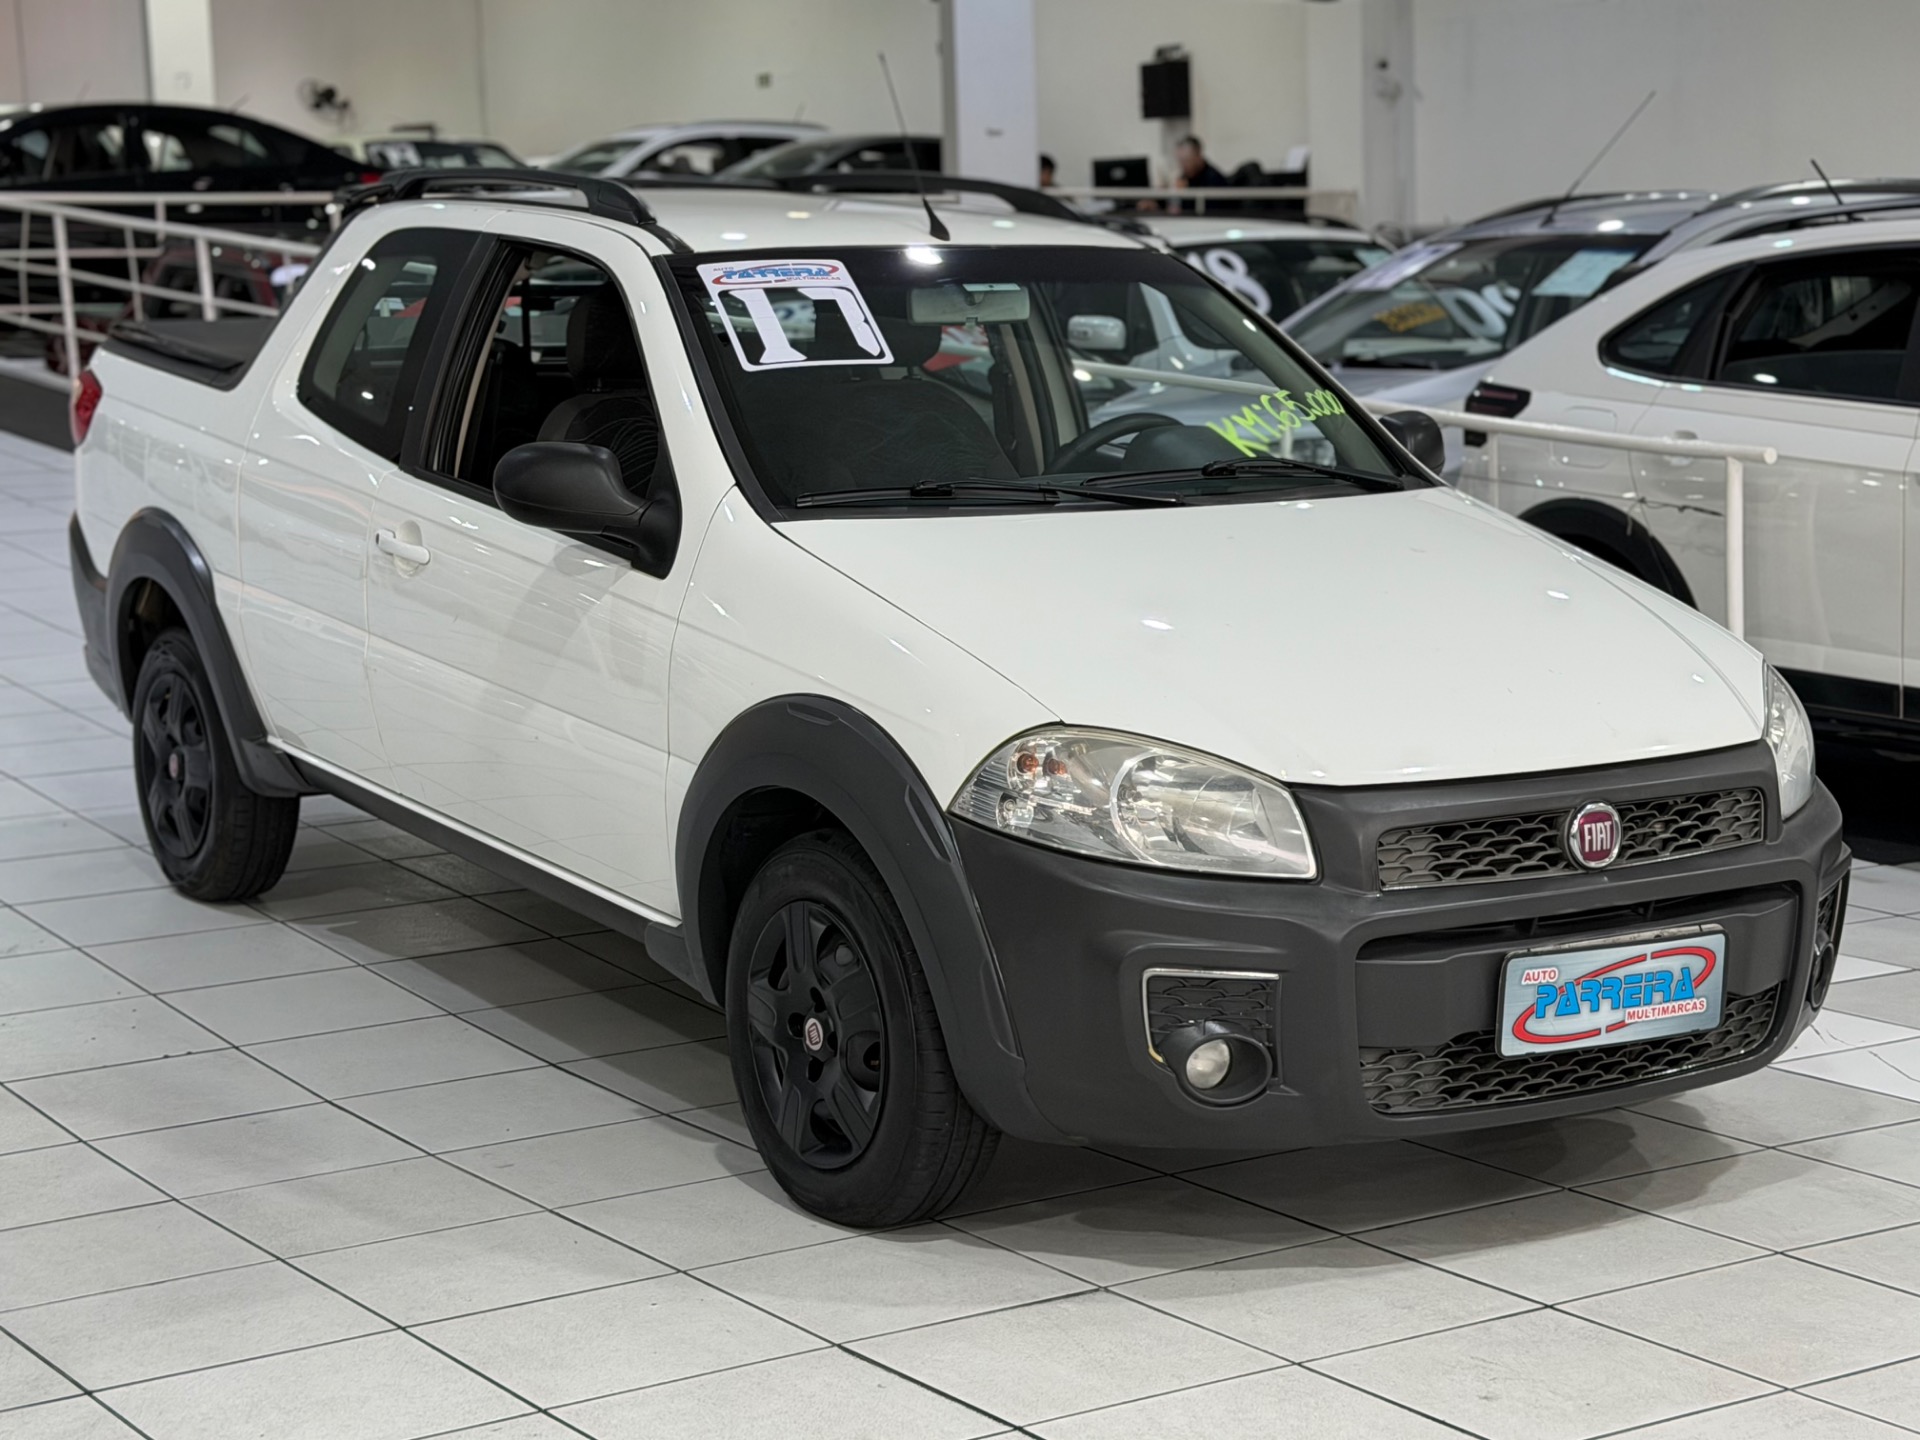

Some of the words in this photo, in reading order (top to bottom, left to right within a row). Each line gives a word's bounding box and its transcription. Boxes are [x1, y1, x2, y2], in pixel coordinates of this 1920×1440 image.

[728, 287, 881, 364] 17
[1583, 820, 1612, 853] FIAT
[1523, 968, 1558, 983] AUTO
[1534, 966, 1696, 1020] PARREIRA
[1626, 999, 1706, 1022] MULTIMARCAS
